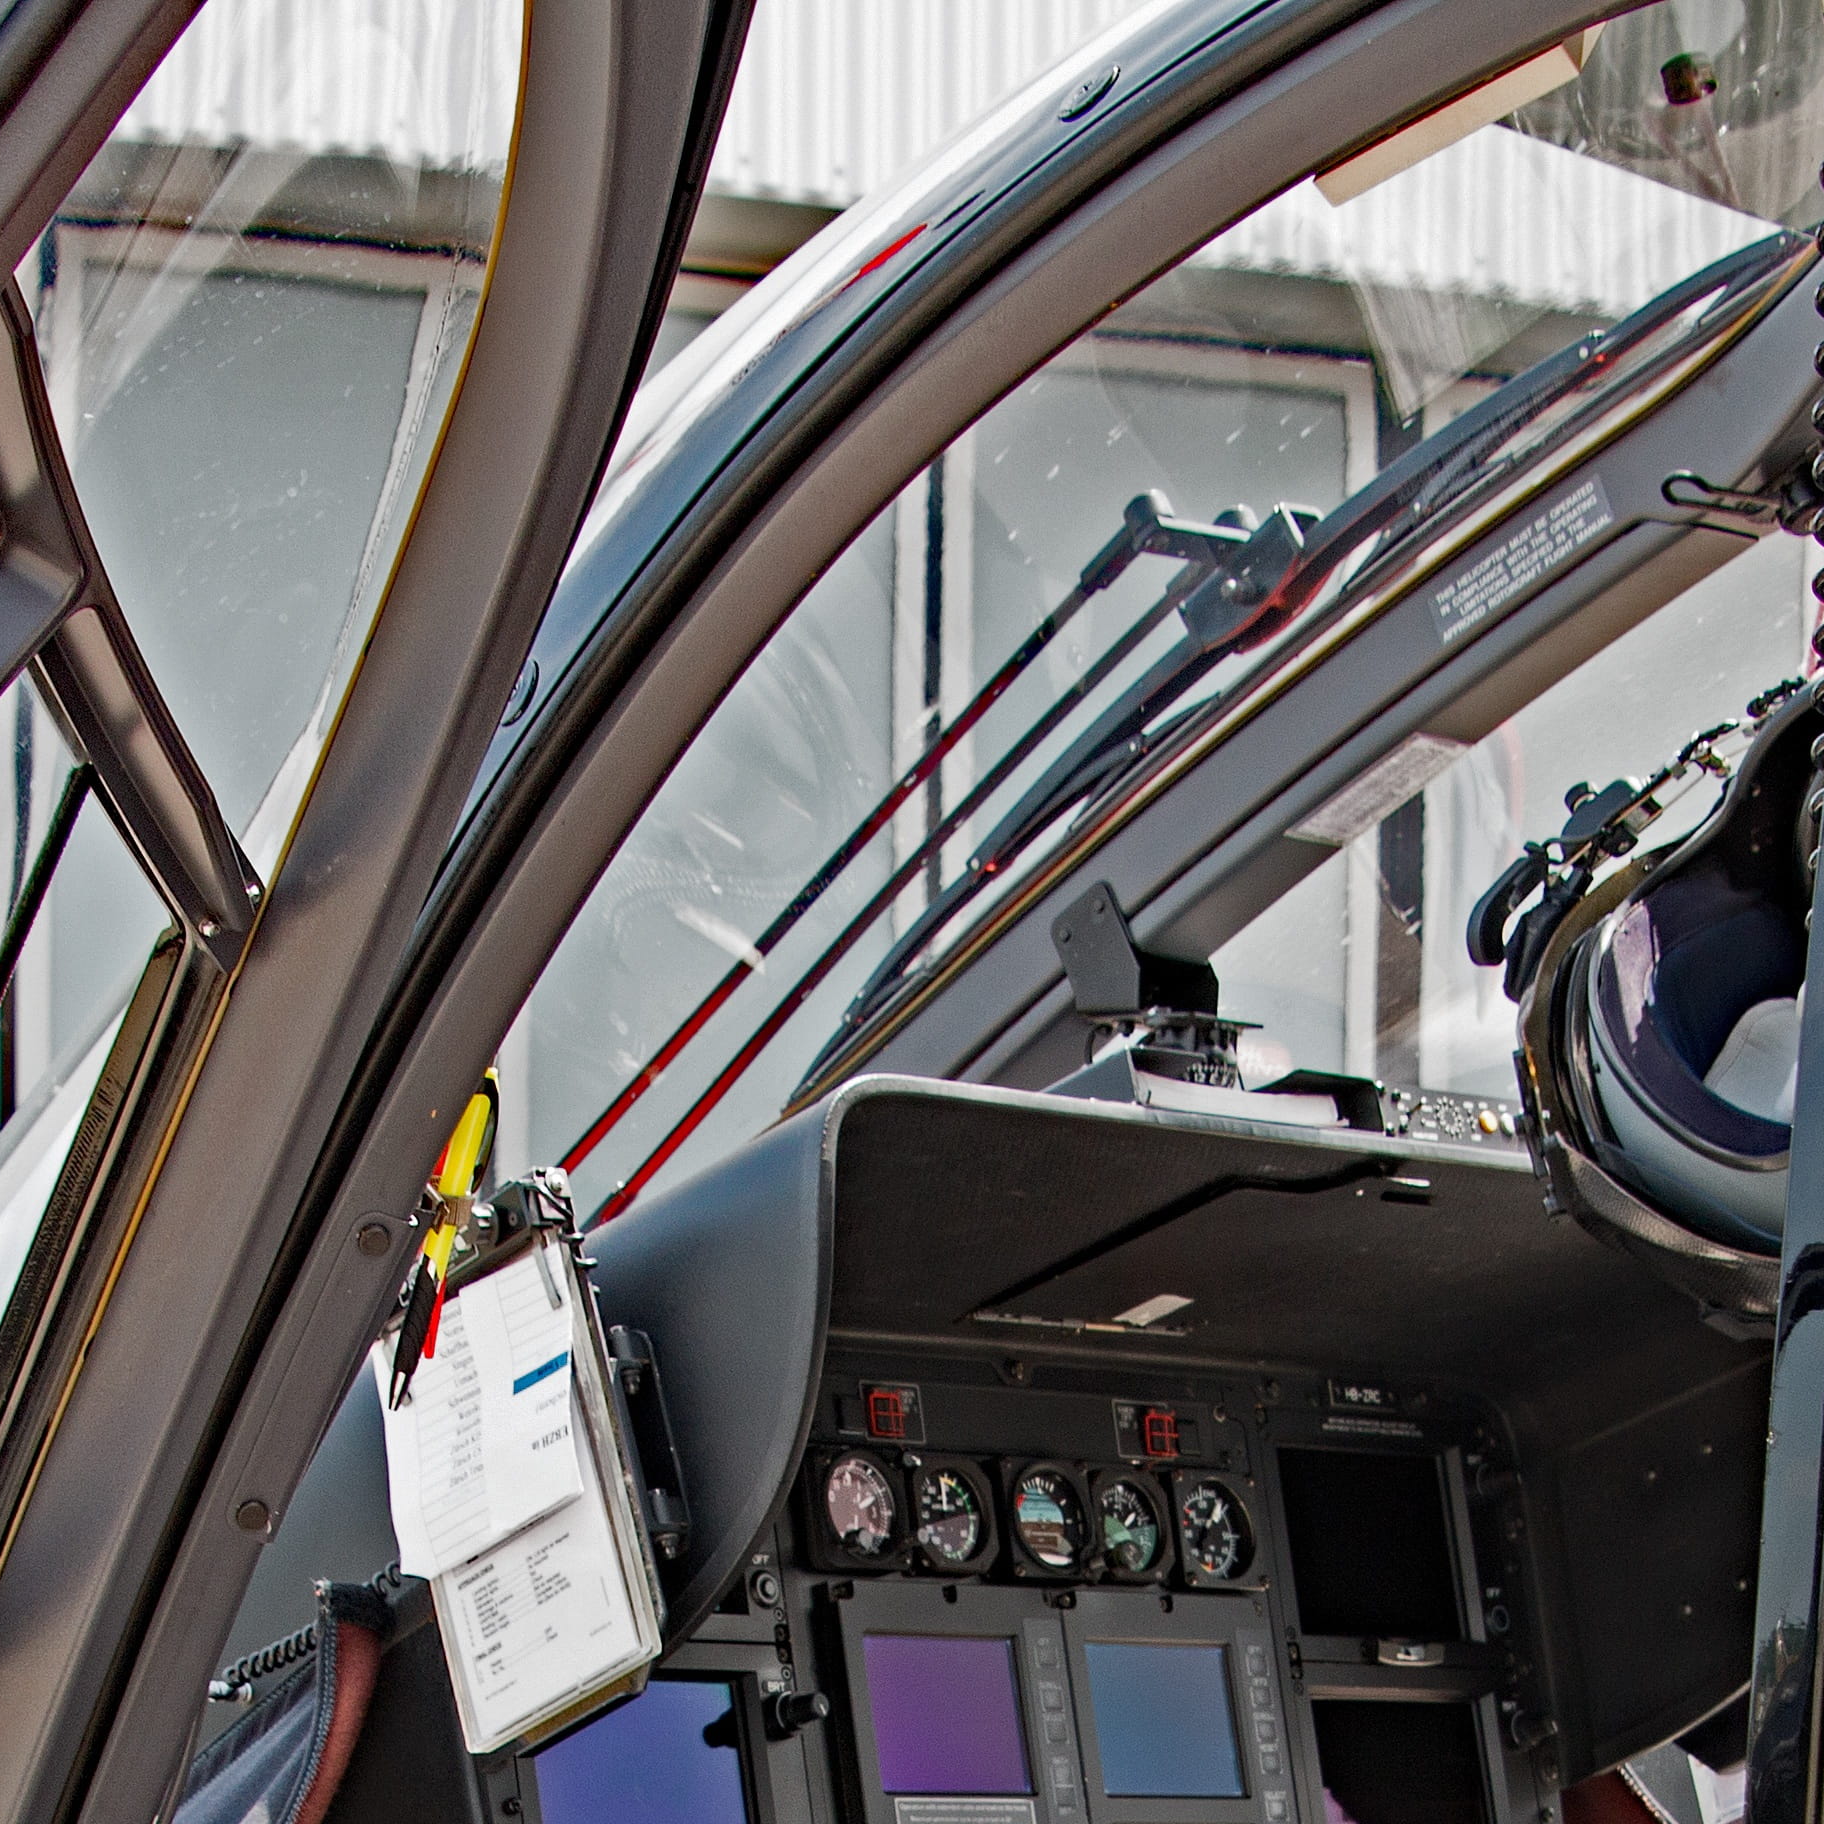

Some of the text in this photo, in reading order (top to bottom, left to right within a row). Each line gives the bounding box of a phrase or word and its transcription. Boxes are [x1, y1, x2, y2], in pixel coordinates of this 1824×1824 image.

[1435, 481, 1594, 605] THIS HELICOPTER MUST BE OPERATED
[1439, 494, 1597, 617] IN COMPLIANCE WITH THE OPERATING
[1443, 513, 1613, 644] APPROVED ROTORCRAFT FLIGHT MANUAL
[1459, 517, 1587, 617] LIMITATIONS SPECIFIED IN THE
